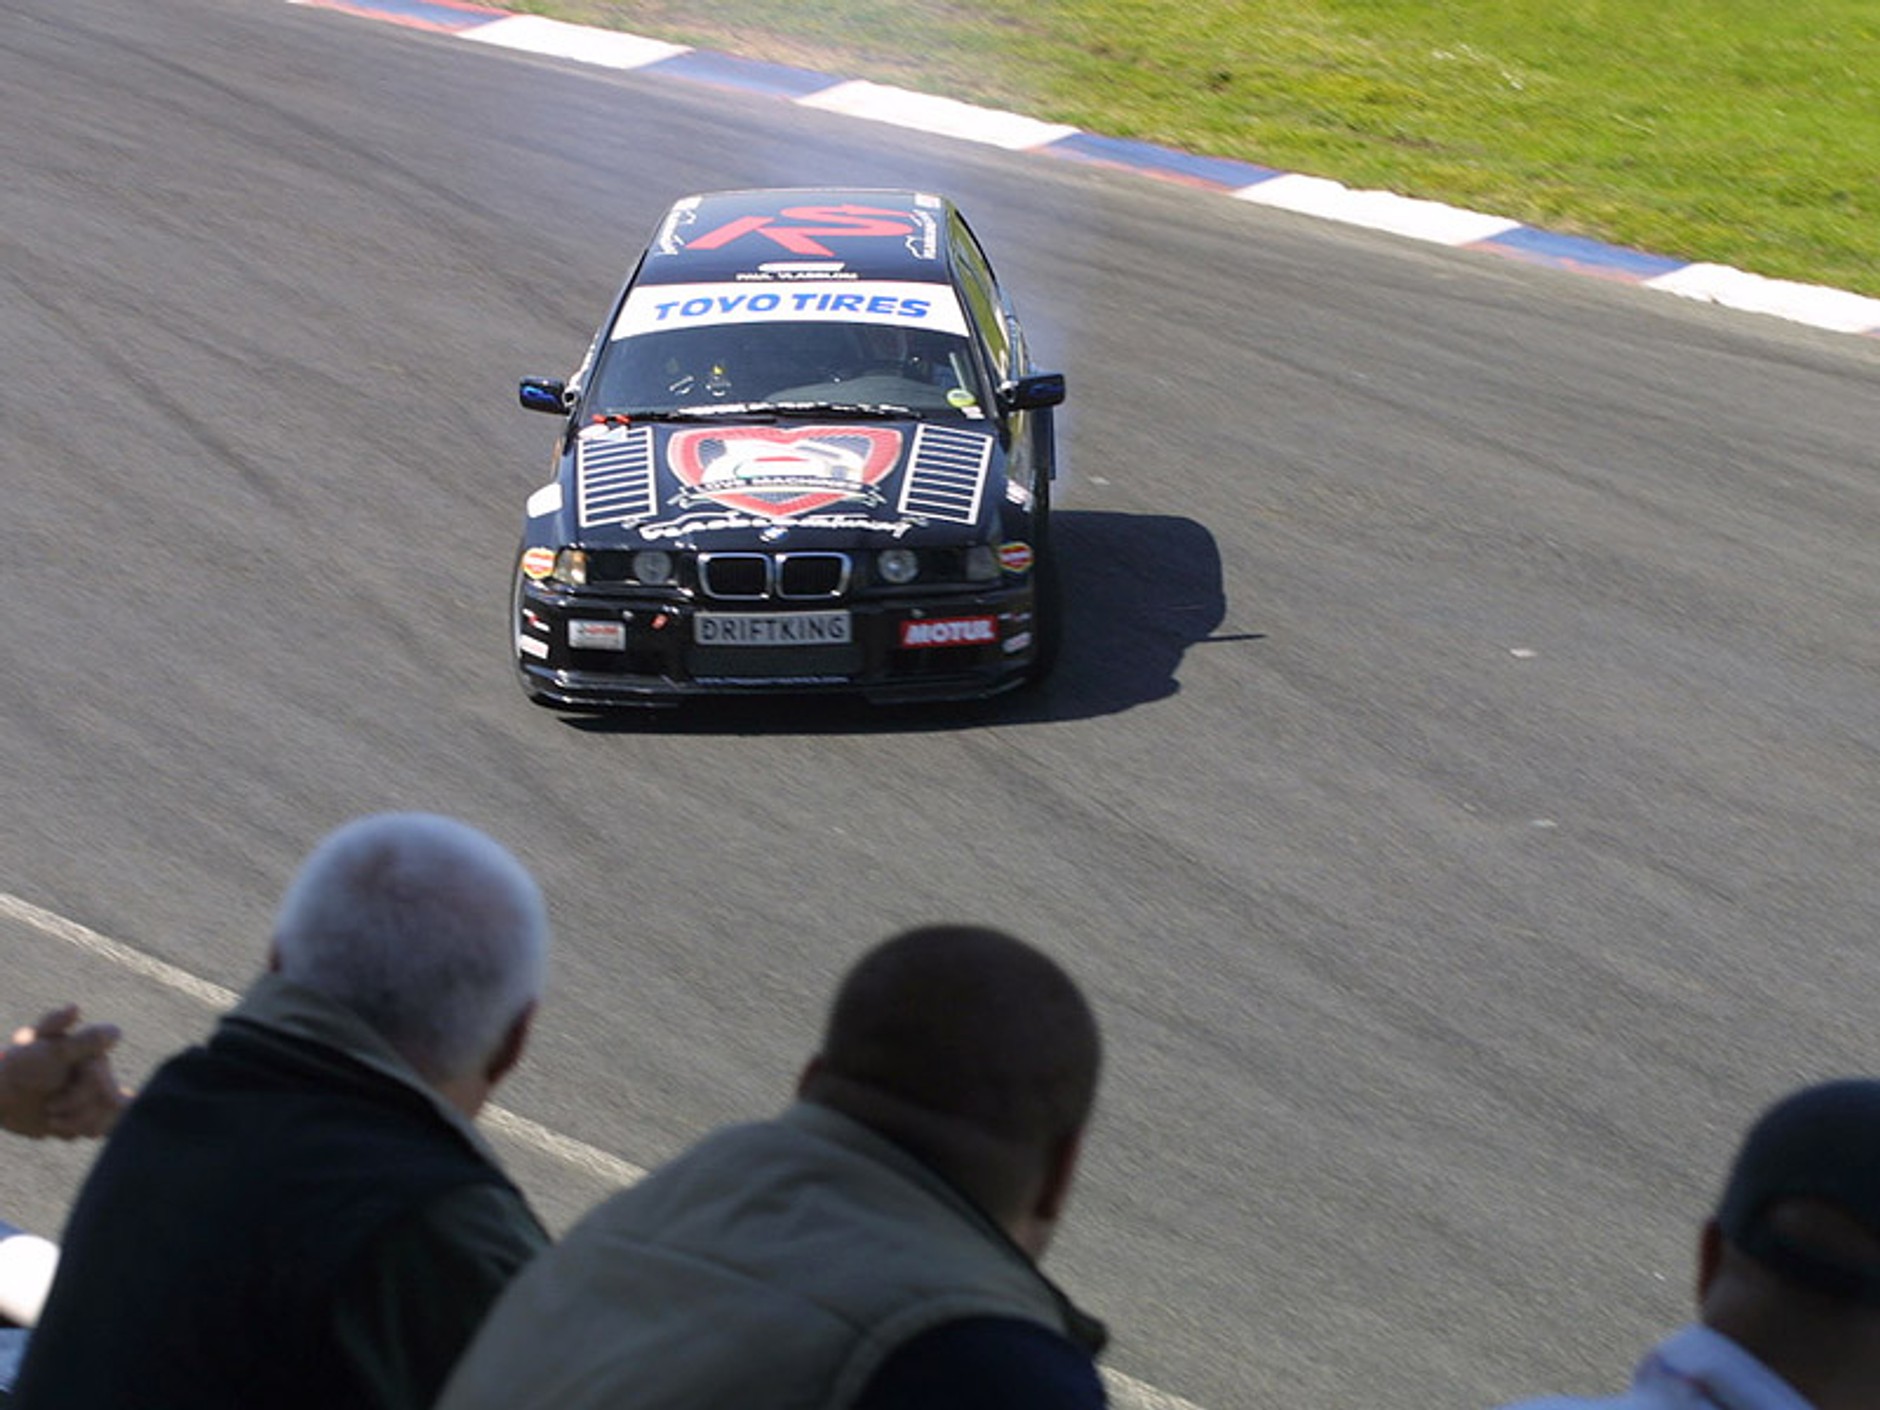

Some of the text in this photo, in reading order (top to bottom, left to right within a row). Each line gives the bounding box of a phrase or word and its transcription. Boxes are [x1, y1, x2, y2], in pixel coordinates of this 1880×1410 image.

[655, 293, 931, 320] TOYO TIRES
[701, 615, 846, 641] DRIFTKING
[903, 619, 993, 645] MOTUL
